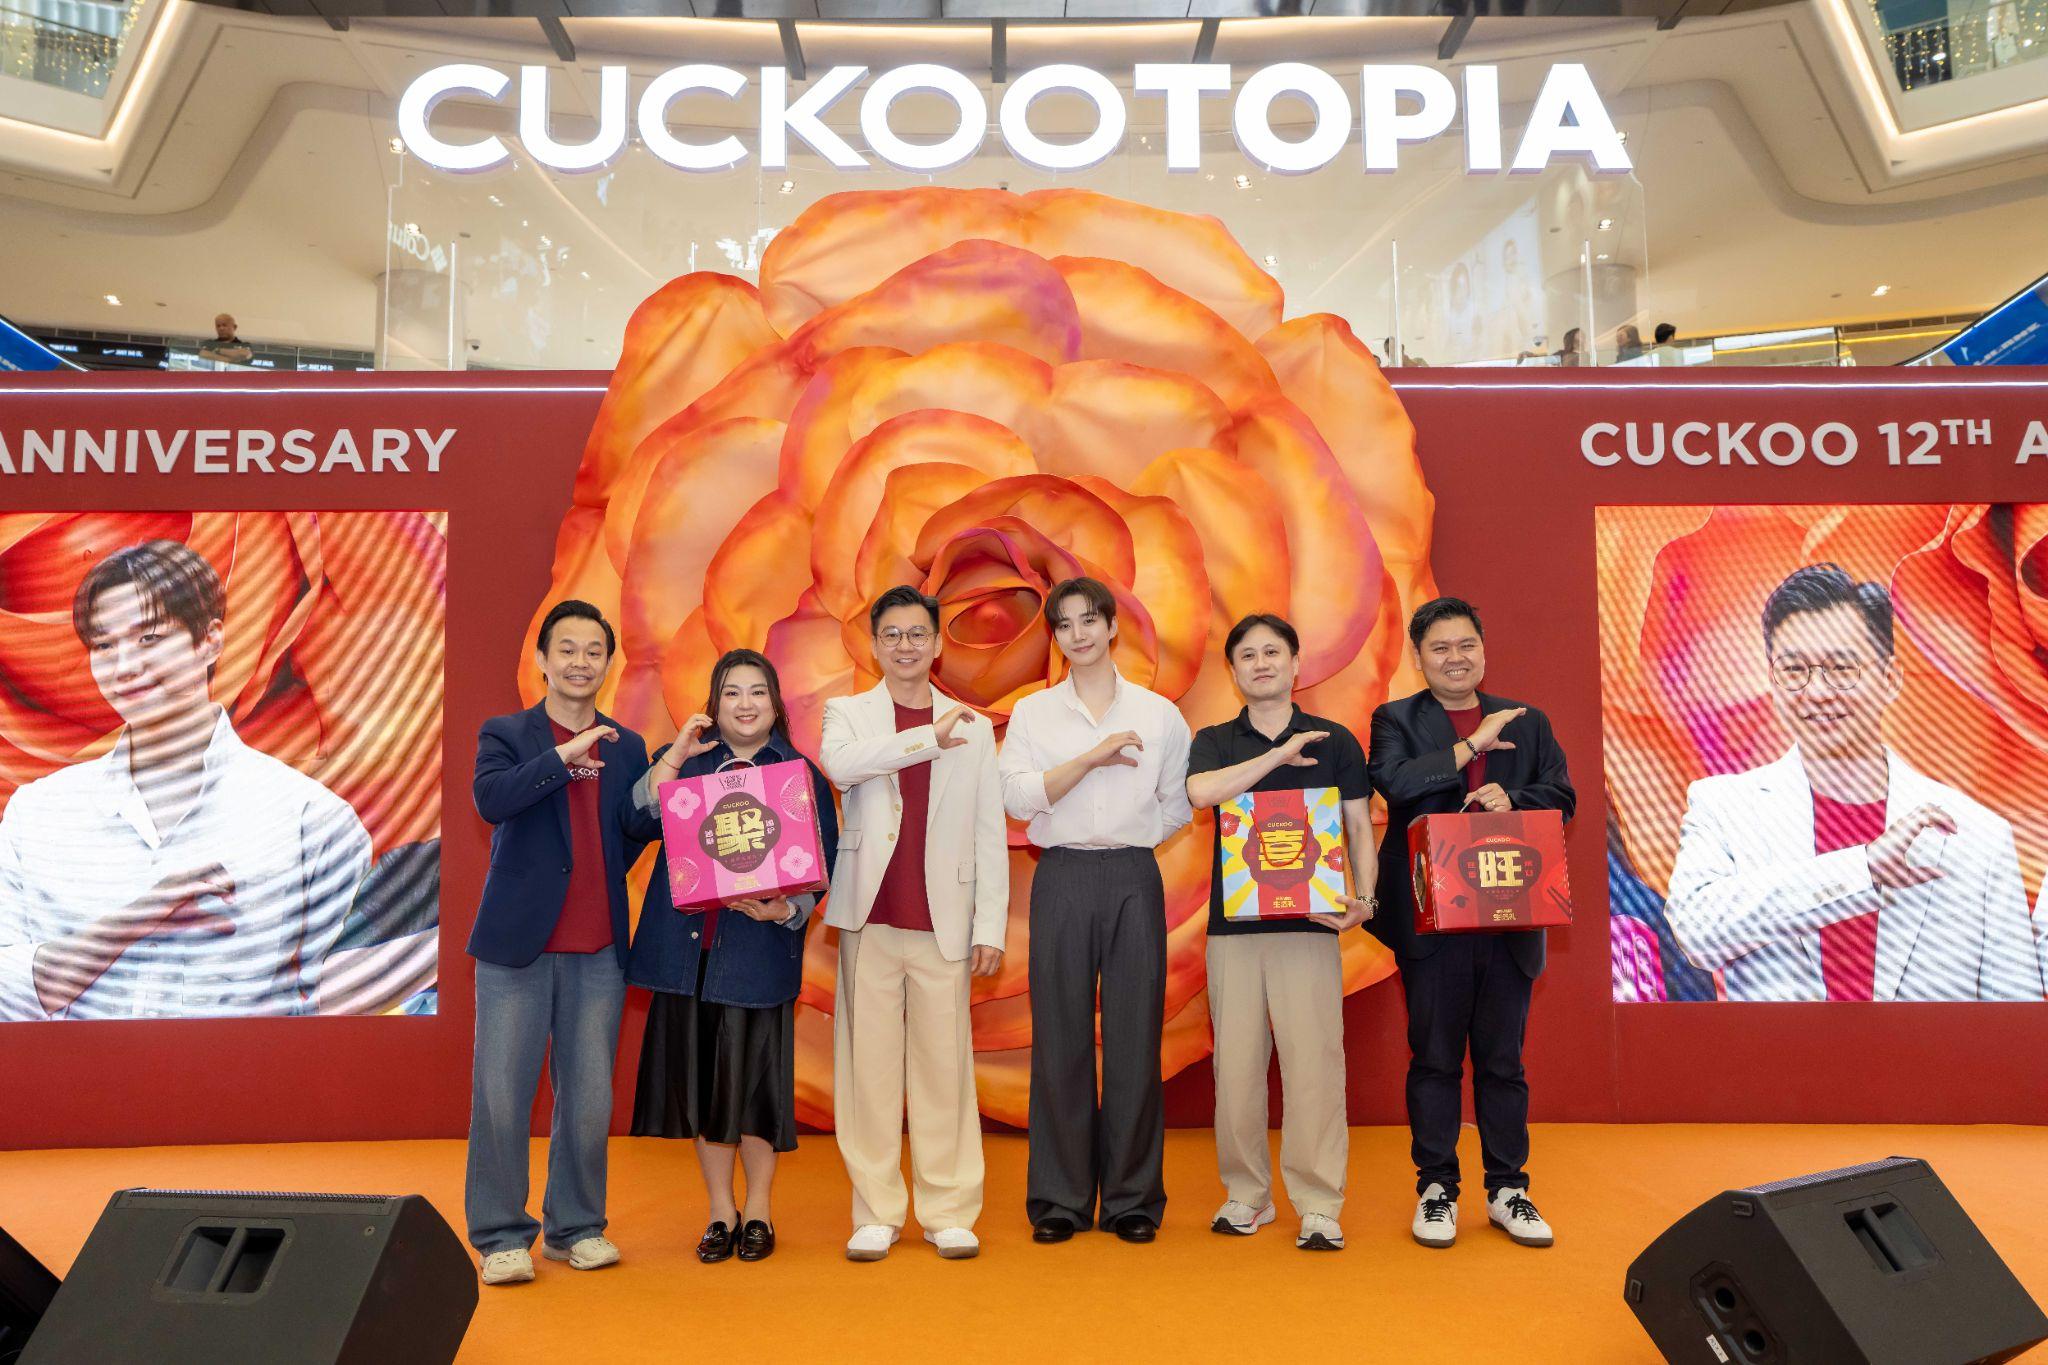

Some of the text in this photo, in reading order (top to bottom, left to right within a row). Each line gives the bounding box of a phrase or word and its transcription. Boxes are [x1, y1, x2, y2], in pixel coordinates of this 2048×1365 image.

[398, 63, 1633, 174] CUCKOOTOPIA
[1580, 422, 1858, 467] CUCKOO
[1878, 419, 1992, 466] 12TH
[722, 801, 750, 809] CUCKOO
[1478, 850, 1523, 887] 旺
